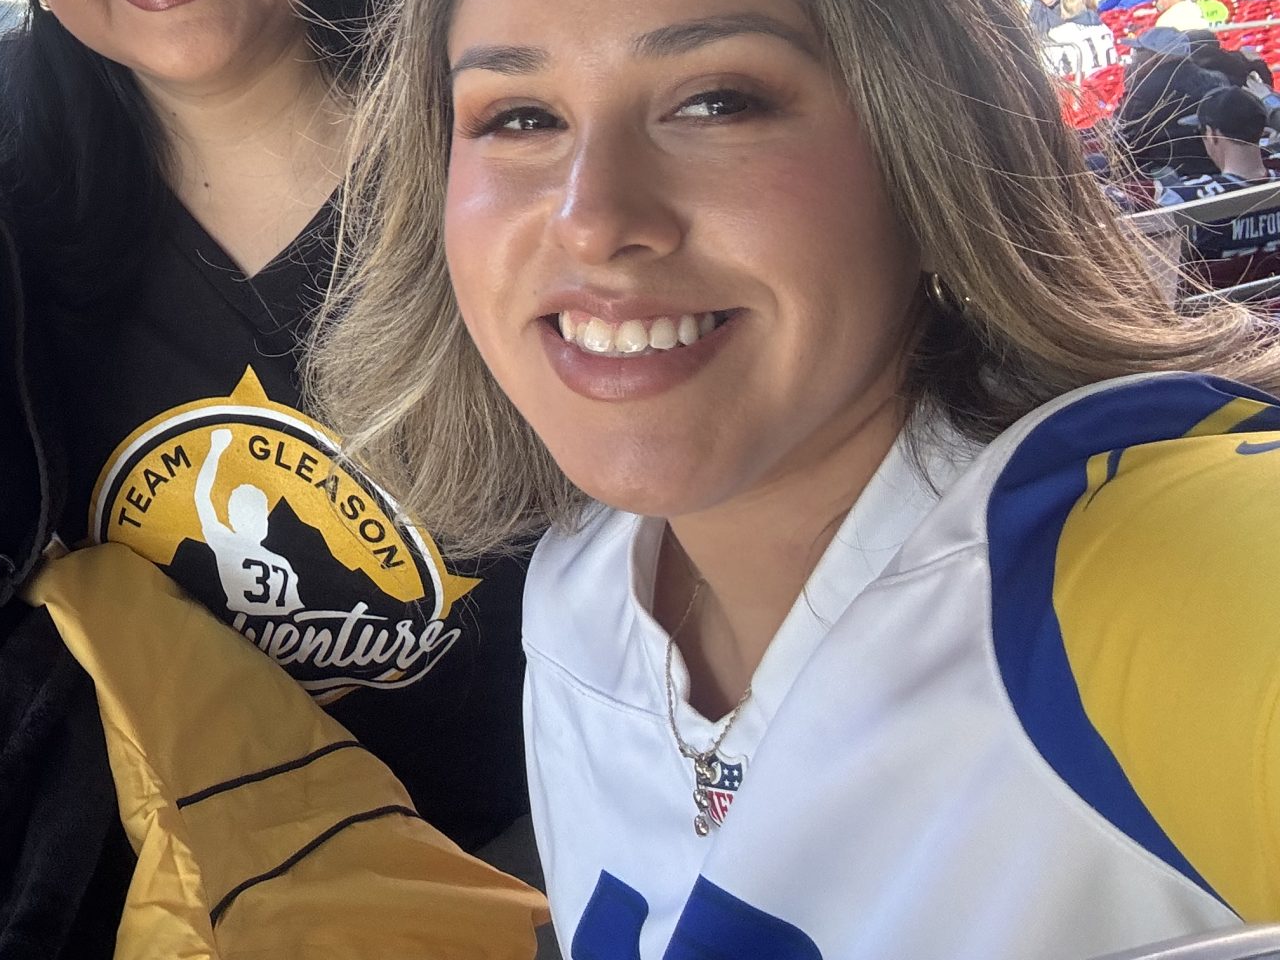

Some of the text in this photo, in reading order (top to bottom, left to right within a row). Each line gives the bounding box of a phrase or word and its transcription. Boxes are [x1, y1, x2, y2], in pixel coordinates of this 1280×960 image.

[118, 435, 406, 572] TEAM GLEASON
[242, 559, 289, 608] 37
[230, 601, 462, 674] venture
